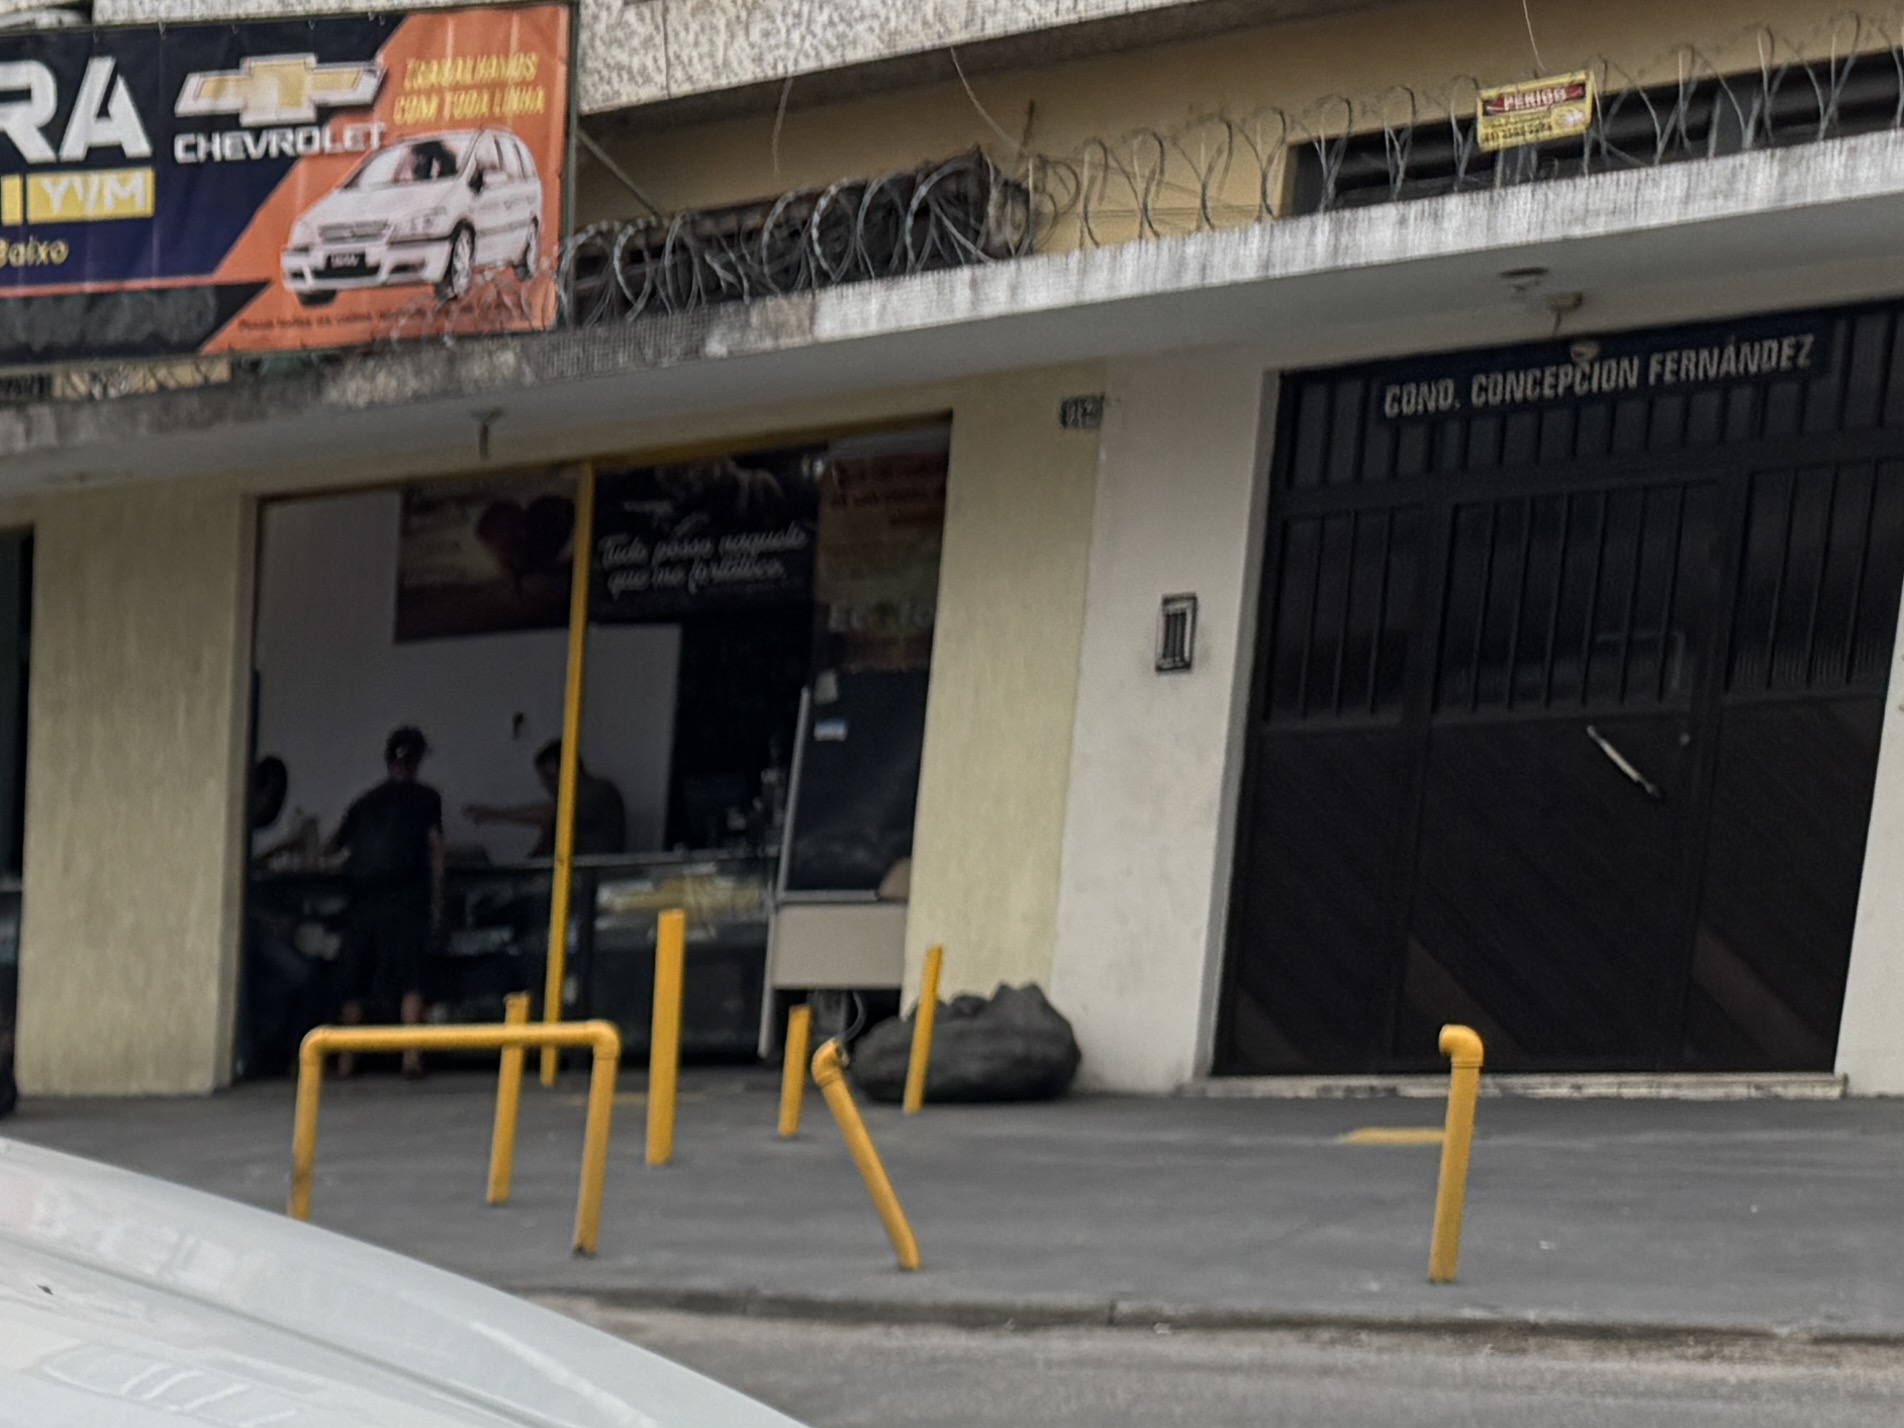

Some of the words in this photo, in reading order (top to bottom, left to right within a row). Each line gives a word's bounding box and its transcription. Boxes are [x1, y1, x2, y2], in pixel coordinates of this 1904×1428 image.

[393, 94, 439, 125] COM
[444, 91, 489, 121] TODA
[493, 86, 545, 116] LINHA
[173, 121, 385, 164] CHEVROLET
[1384, 377, 1460, 418] COND.
[1649, 334, 1814, 387] FERNÁNDEZ
